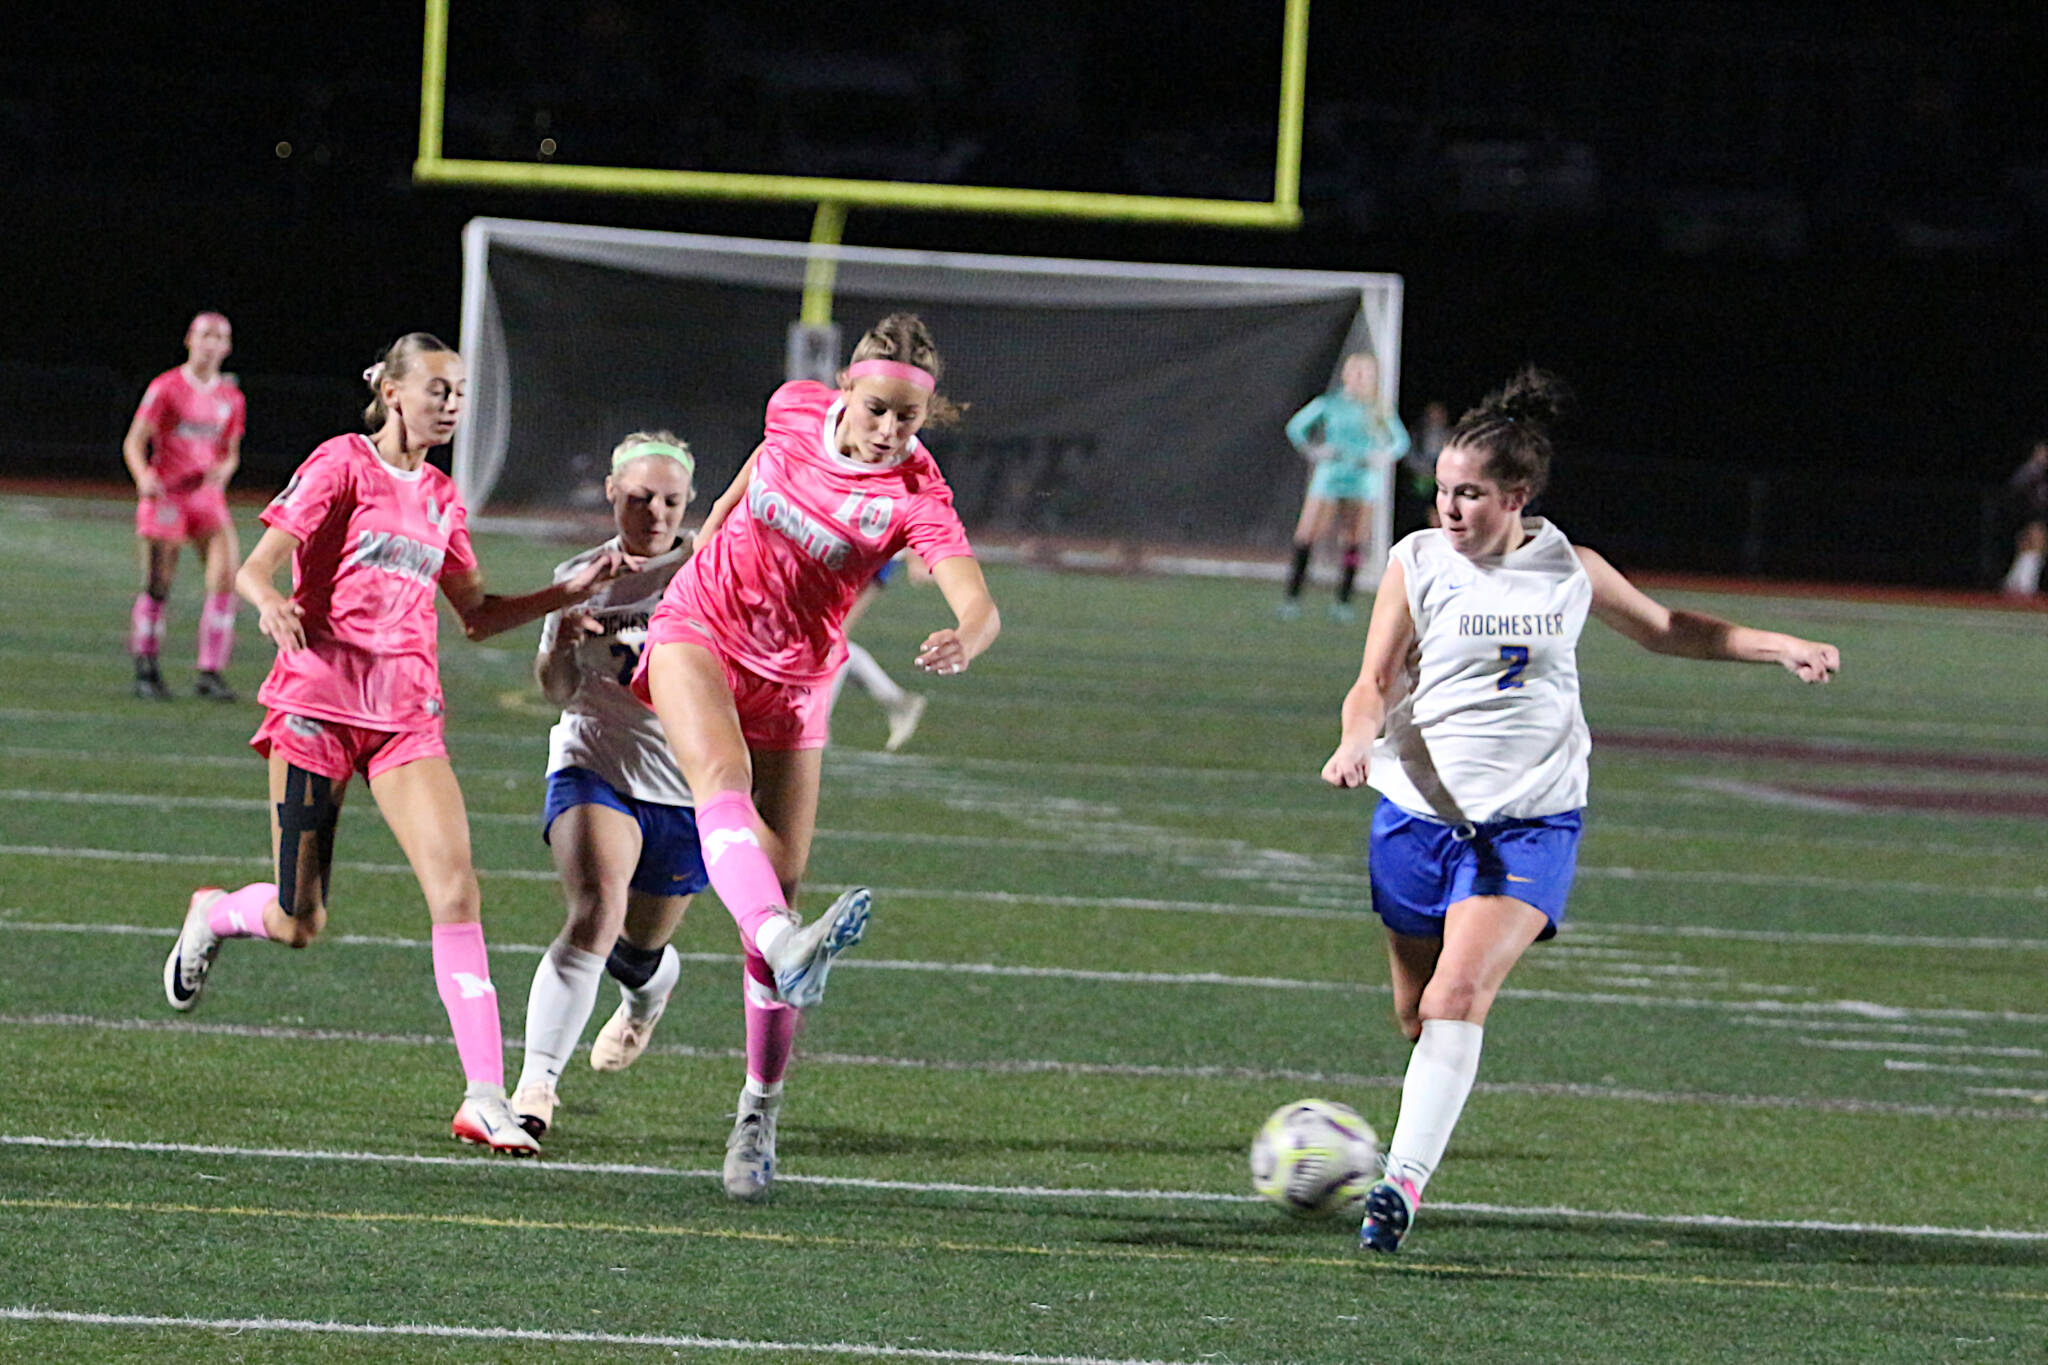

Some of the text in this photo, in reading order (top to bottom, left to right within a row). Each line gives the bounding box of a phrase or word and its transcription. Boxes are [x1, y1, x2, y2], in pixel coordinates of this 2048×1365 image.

[831, 488, 893, 538] 10
[1458, 612, 1564, 636] ROCHESTER
[1496, 644, 1531, 691] 2
